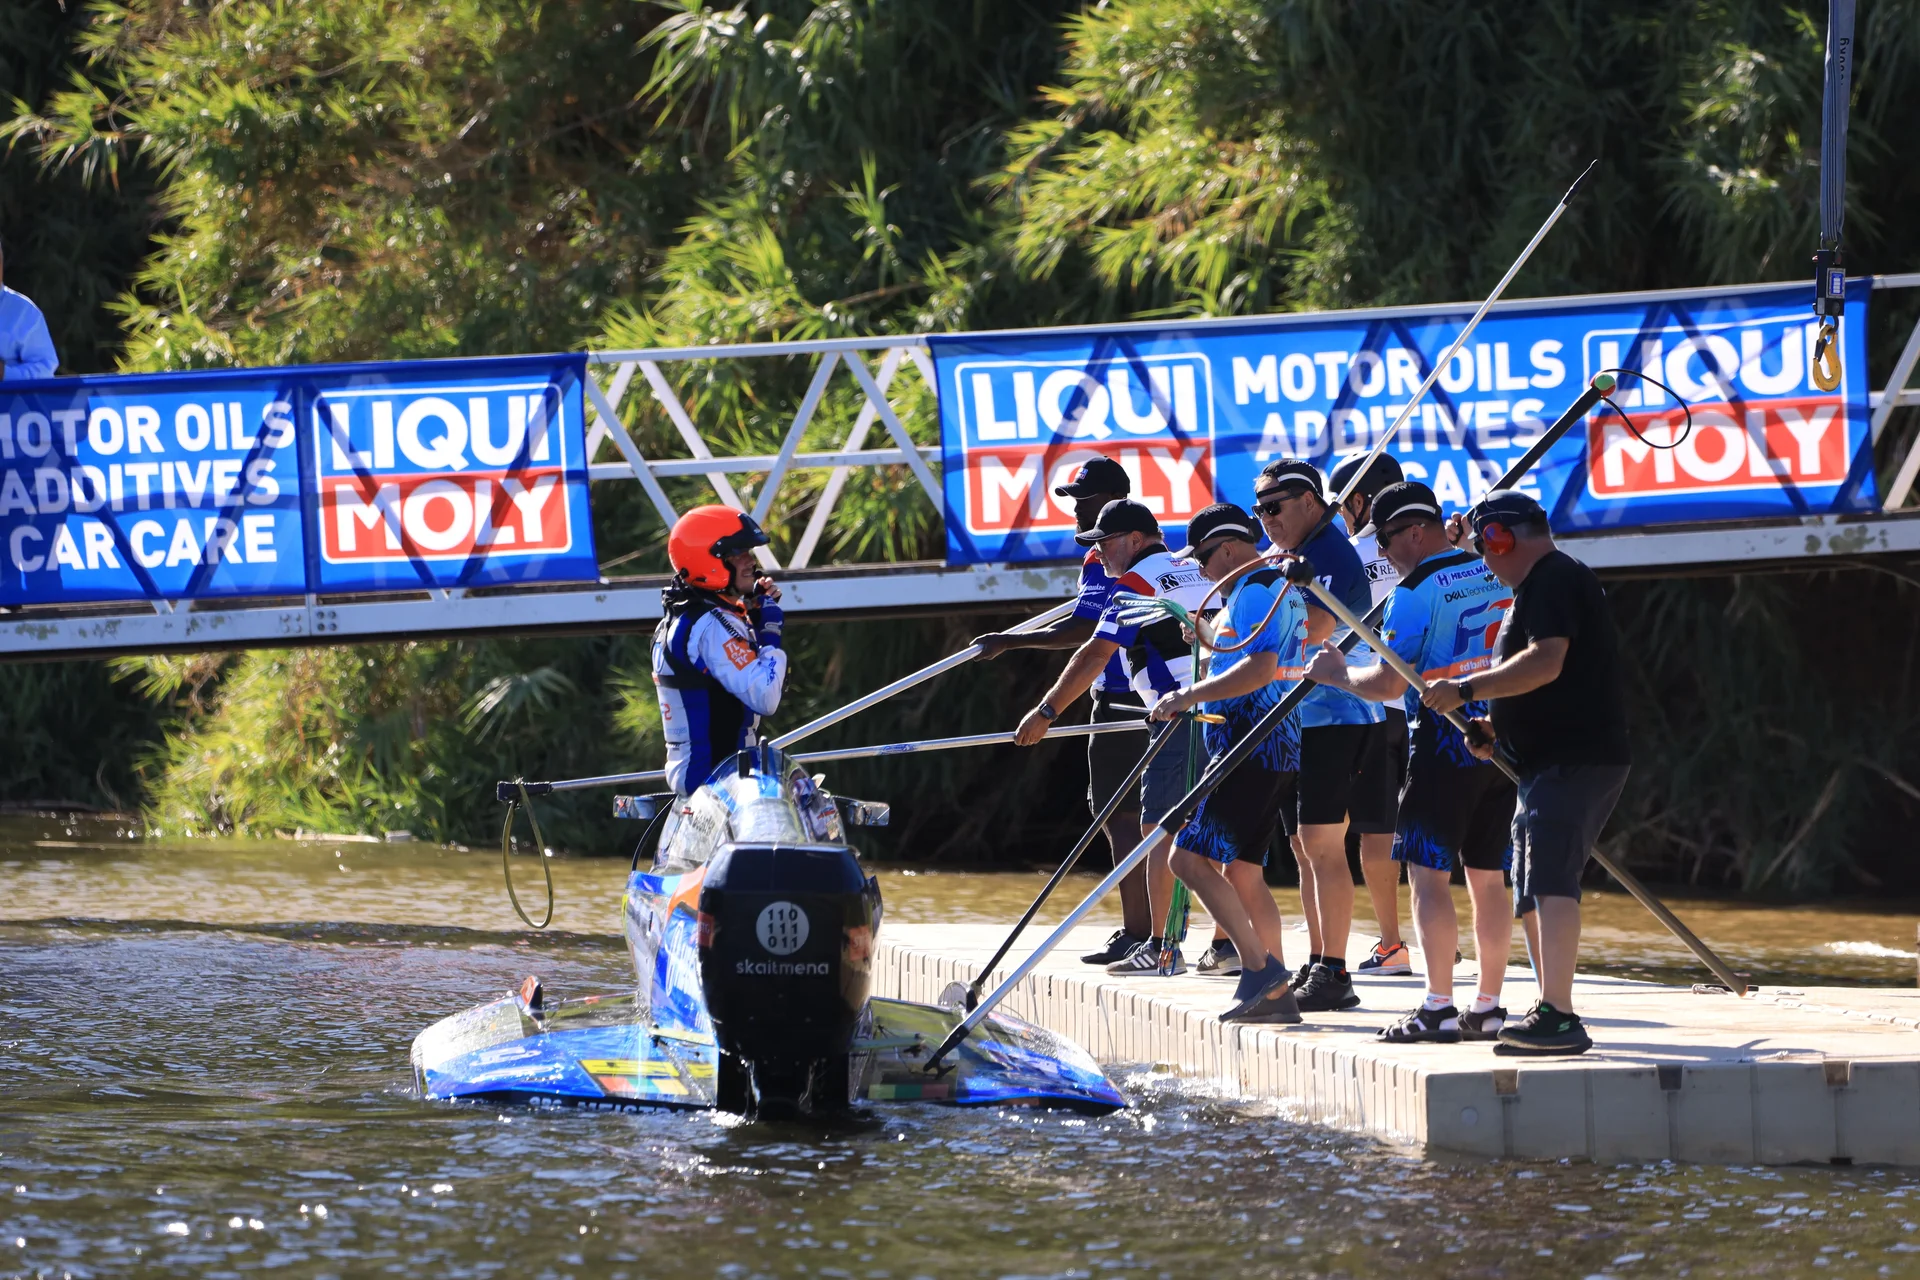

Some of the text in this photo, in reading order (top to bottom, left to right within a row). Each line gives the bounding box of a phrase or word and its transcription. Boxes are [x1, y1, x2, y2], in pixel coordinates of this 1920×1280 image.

[1232, 340, 1566, 406] MOTOR OILS
[1599, 322, 1829, 405] LIQUI
[174, 401, 296, 452] OILS
[972, 363, 1199, 440] LIQUI
[1254, 399, 1548, 461] ADDITIVES
[331, 394, 554, 472] LIQUI
[1602, 404, 1840, 488] MOLY
[0, 458, 281, 516] ADDITIVES
[335, 474, 558, 553] MOLY
[9, 513, 278, 572] CAR CARE
[1444, 589, 1468, 604] DELL
[767, 908, 799, 921] 110
[767, 922, 799, 935] 111
[767, 935, 799, 949] 011
[735, 958, 830, 976] skaitmena
